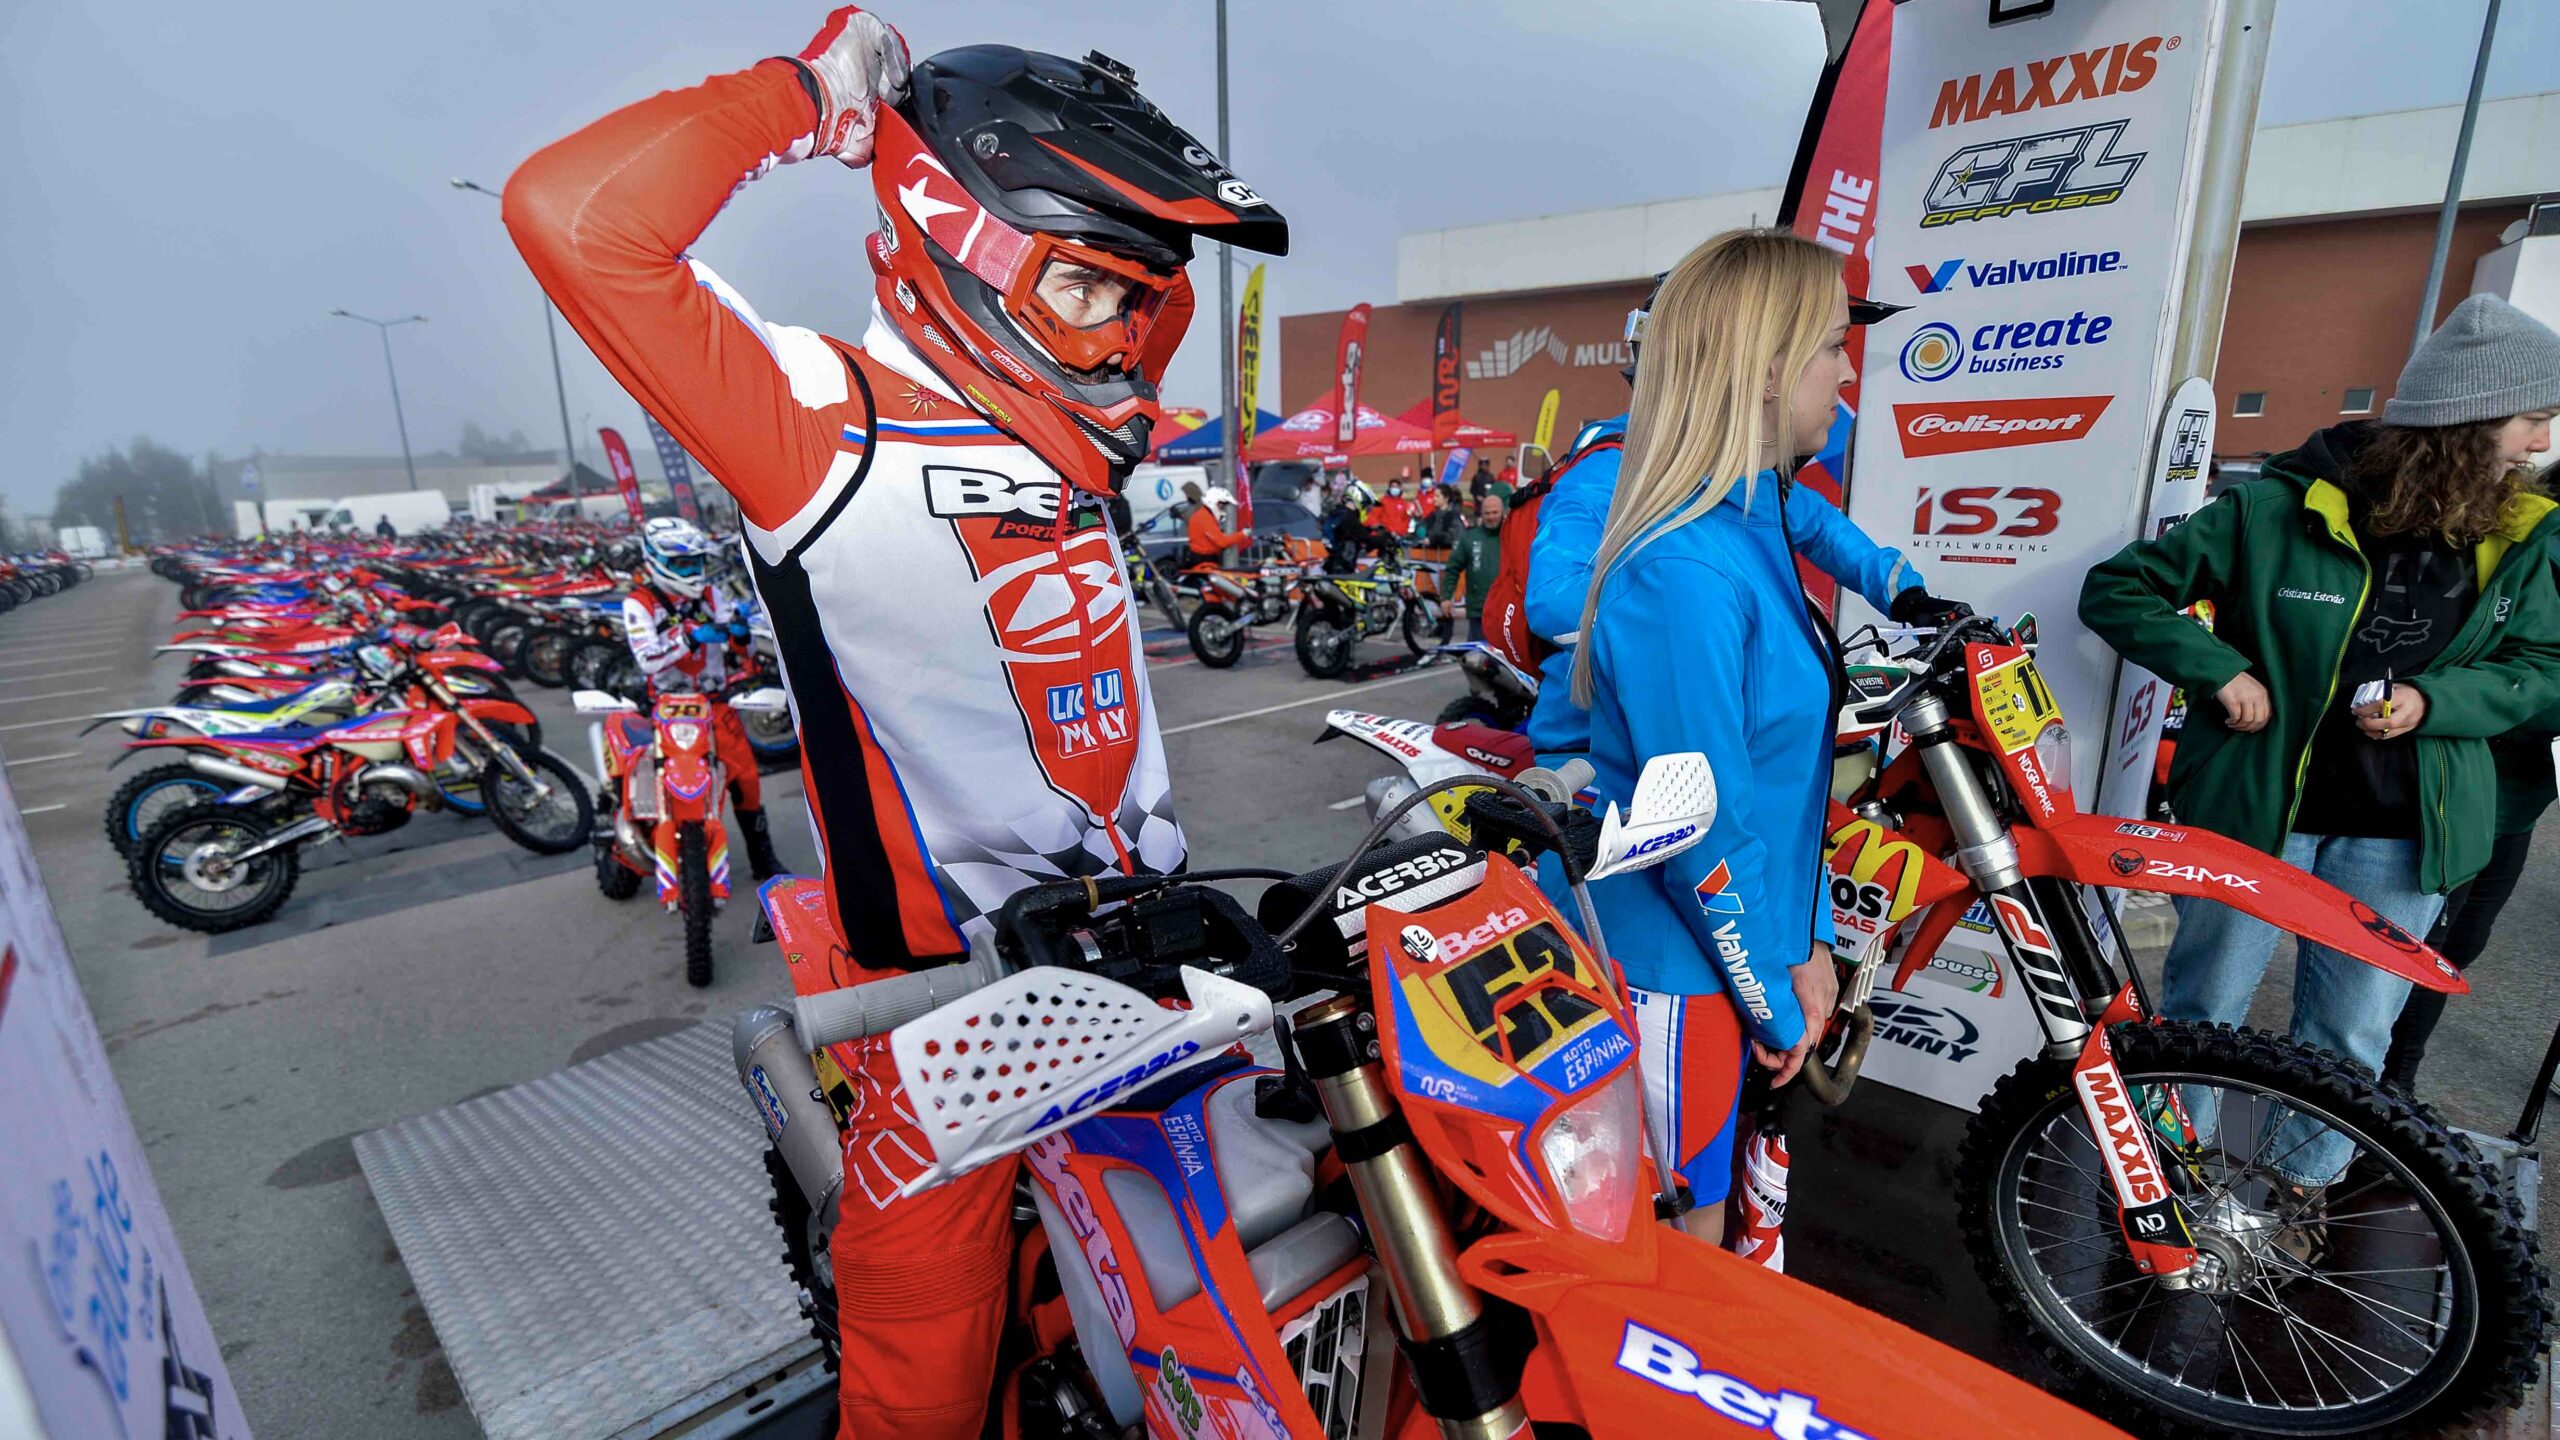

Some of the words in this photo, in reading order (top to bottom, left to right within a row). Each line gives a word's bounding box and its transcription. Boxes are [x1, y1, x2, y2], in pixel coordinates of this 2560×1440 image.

[1928, 37, 2162, 129] MAXXIS
[1923, 119, 2149, 213] CFL
[1815, 169, 1873, 255] THE
[1967, 250, 2121, 289] Valvoline
[1972, 310, 2112, 352] create
[1574, 342, 1635, 367] MULT
[1968, 352, 2065, 374] business
[1908, 412, 2083, 438] Polisport
[922, 465, 1106, 518] Bea
[1913, 541, 1962, 550] METAL
[1972, 542, 2048, 553] WORKING
[2278, 587, 2312, 600] Cristiana
[2313, 591, 2345, 605] Estevão
[1052, 673, 1121, 721] LIQUI
[1855, 676, 1885, 687] SILVESTRE
[1060, 707, 1128, 754] MOLY
[1373, 731, 1423, 759] MAXXIS
[1466, 748, 1513, 768] GUTS
[2018, 752, 2055, 819] NDGRAPHIC
[1828, 876, 1884, 919] OS
[2145, 860, 2262, 894] 24MX
[1437, 906, 1530, 965] Beta
[1835, 934, 1856, 950] ar
[1711, 918, 1774, 1021] Valvoline
[1444, 921, 1603, 1064] 52
[1562, 1038, 1592, 1063] MOTO
[1566, 1033, 1632, 1089] ESPINHA
[1872, 1021, 1980, 1063] ENNY
[750, 1065, 786, 1129] Beta
[1165, 1116, 1205, 1178] ESPINHA
[1183, 1113, 1204, 1143] MOTO
[2085, 1071, 2161, 1205] MAXXIS
[1024, 1130, 1138, 1350] Beta
[2135, 1213, 2166, 1234] ND
[1615, 1318, 1877, 1440] Bet
